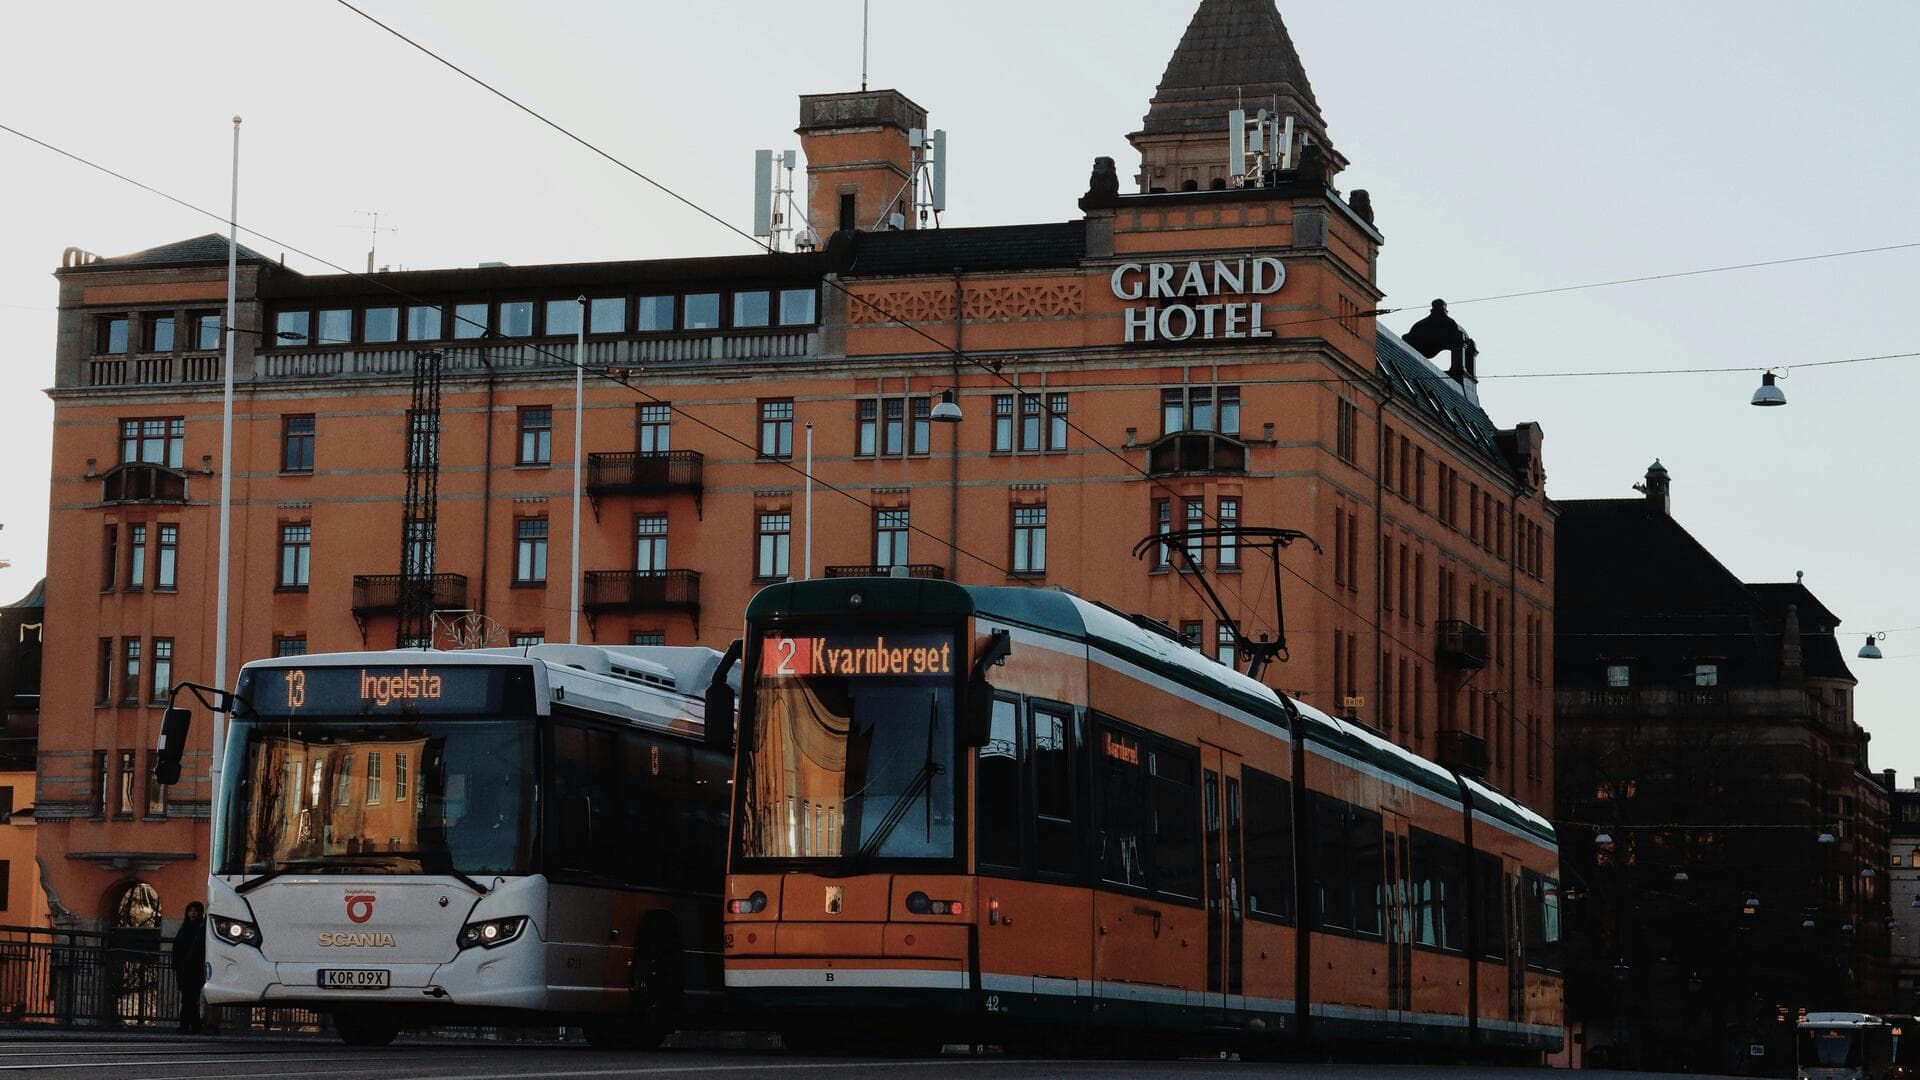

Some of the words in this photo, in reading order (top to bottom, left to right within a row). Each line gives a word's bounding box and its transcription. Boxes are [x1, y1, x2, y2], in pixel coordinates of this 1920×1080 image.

[1110, 257, 1286, 300] GRAND
[1124, 302, 1273, 343] HOTEL
[777, 637, 797, 675] 2
[812, 636, 951, 674] Kvarnberget
[285, 670, 305, 707] 13
[360, 668, 442, 706] Ingelsta
[318, 931, 396, 948] SCANIA
[329, 971, 354, 985] KOR
[358, 971, 383, 985] 09X
[825, 972, 835, 982] B
[985, 995, 999, 1012] 42
